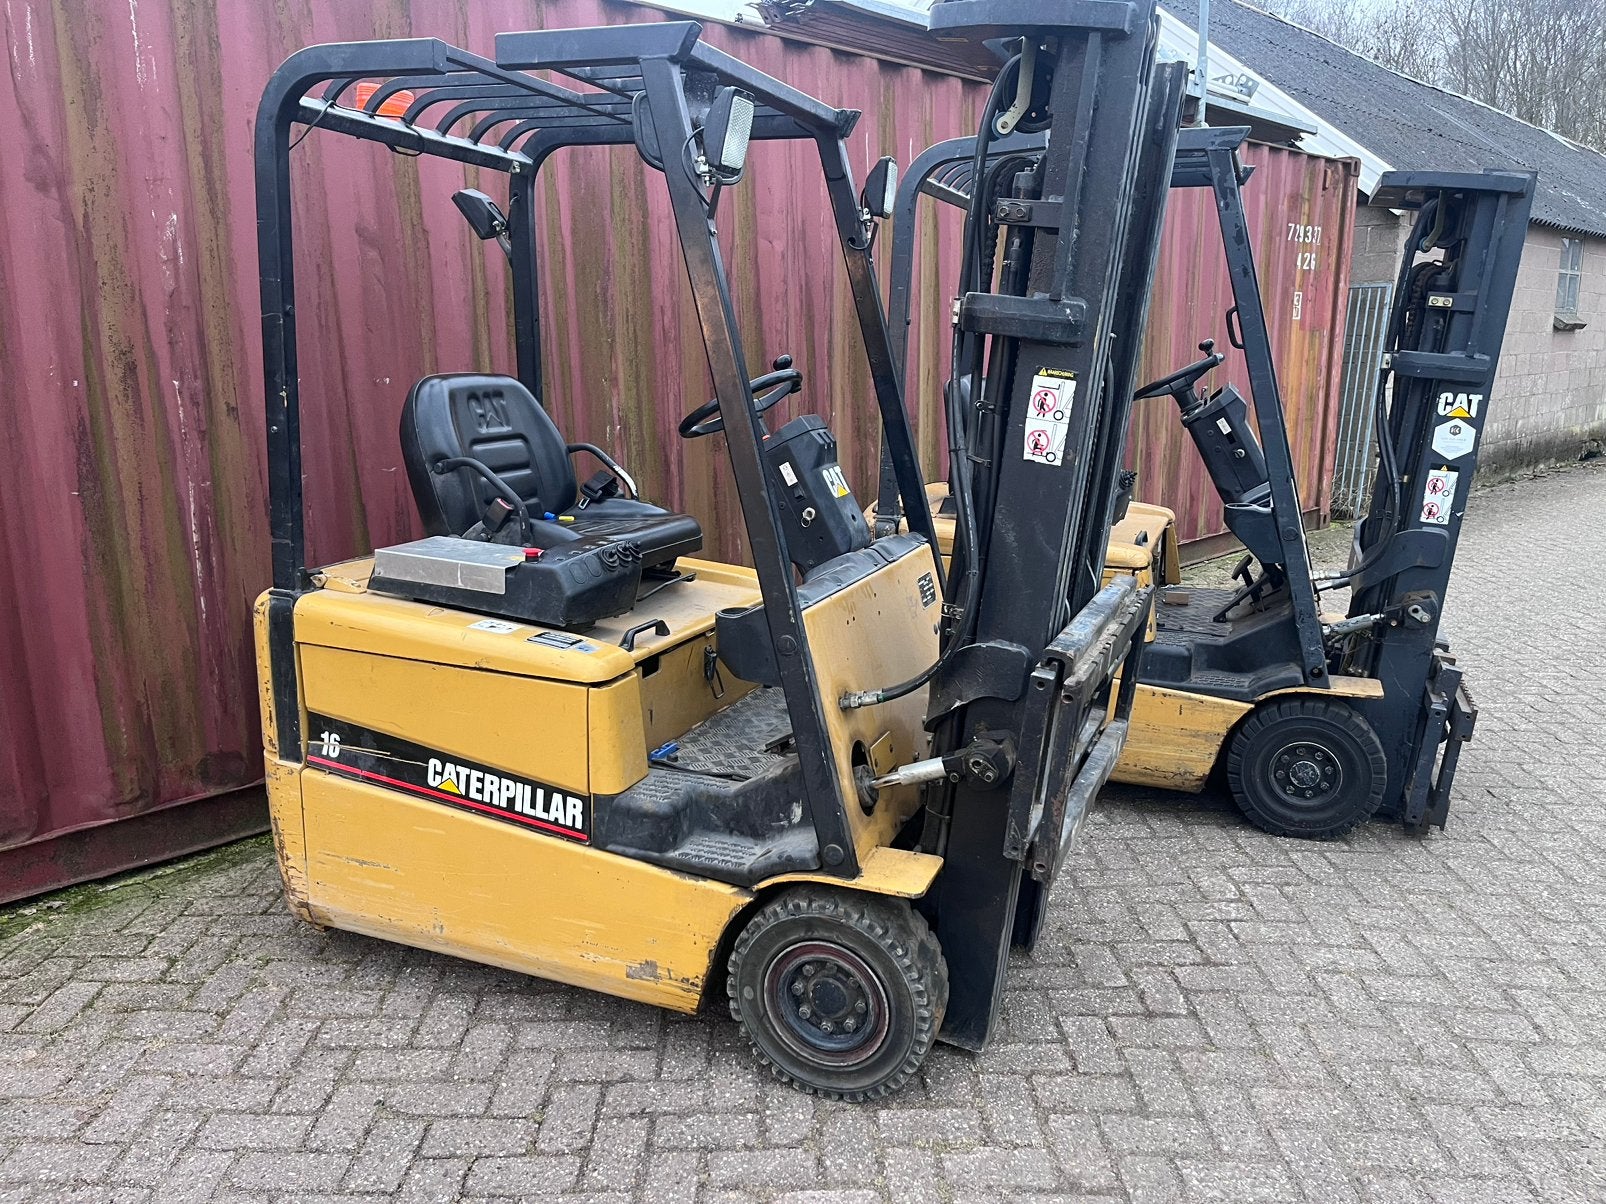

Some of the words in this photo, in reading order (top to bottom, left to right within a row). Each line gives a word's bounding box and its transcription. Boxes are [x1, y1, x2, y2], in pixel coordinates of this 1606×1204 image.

[1437, 391, 1484, 418] CAT
[822, 465, 851, 499] CAT
[320, 730, 341, 758] 16
[427, 757, 584, 830] CATERPILLAR
